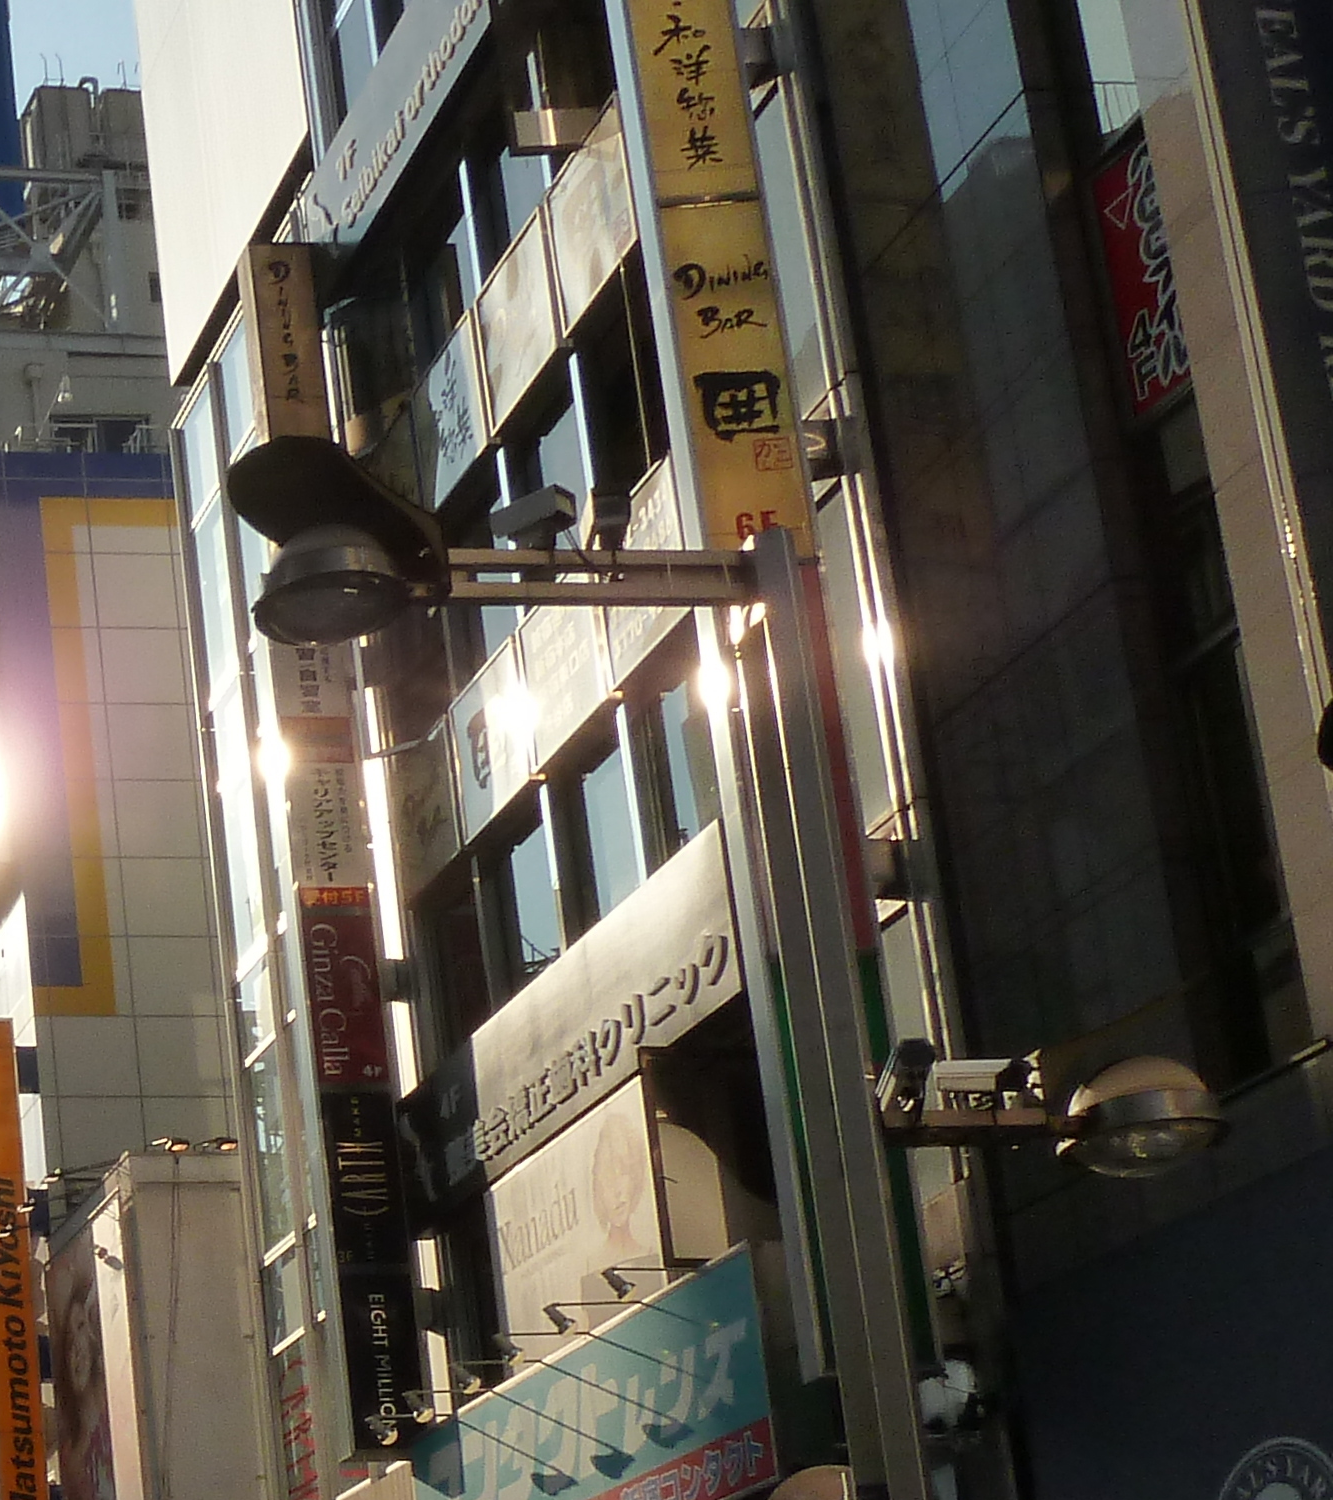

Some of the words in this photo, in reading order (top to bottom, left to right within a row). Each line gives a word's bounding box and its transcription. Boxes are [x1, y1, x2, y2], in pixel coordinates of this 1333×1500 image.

[697, 305, 767, 340] BAR
[310, 922, 337, 996] Ginza
[318, 1007, 350, 1077] Calla
[499, 1184, 581, 1276] Xanadu
[367, 1293, 390, 1350] EIGHT
